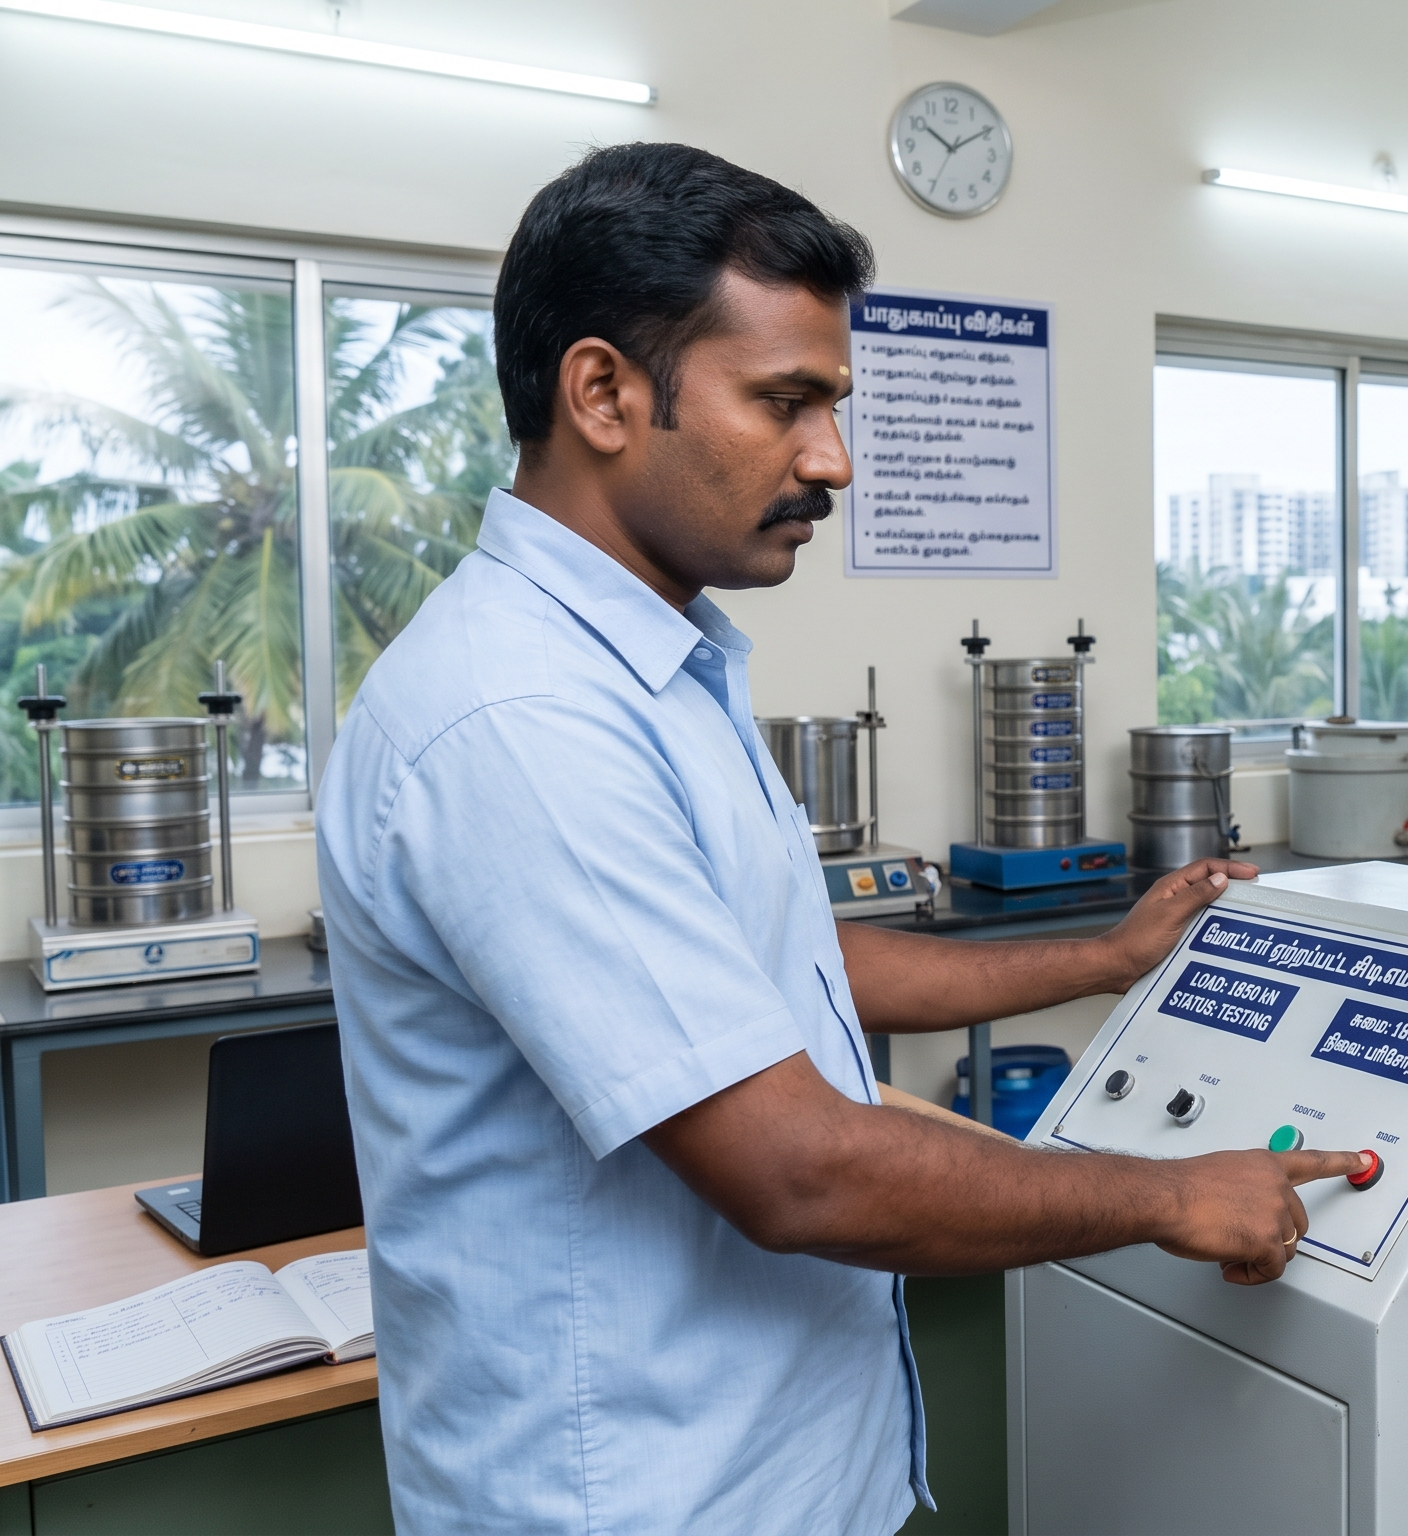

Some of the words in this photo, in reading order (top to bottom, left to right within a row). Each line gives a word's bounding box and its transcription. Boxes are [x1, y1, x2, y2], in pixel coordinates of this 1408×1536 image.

[925, 101, 937, 116] 11
[943, 97, 959, 114] 12
[909, 115, 927, 132] 10
[905, 138, 916, 153] 9
[987, 148, 996, 163] 3
[912, 161, 922, 176] 8
[982, 170, 991, 183] 4
[928, 179, 937, 195] 7
[968, 184, 977, 199] 5
[948, 188, 958, 203] 6
[863, 305, 961, 336] பாதுகாப்பு
[963, 309, 1035, 338] விதிகள்
[1202, 922, 1275, 956] மோட்டார்
[1268, 940, 1346, 974] ஏற்றப்பட்ட
[1189, 971, 1228, 993] LOAD:
[1227, 980, 1261, 1001] 1850
[1257, 987, 1280, 1006] kN
[1169, 990, 1218, 1017] STATUS:
[1217, 1003, 1272, 1031] TESTING
[1350, 1013, 1392, 1035] சுமை:
[1320, 1032, 1365, 1057] நிலை:
